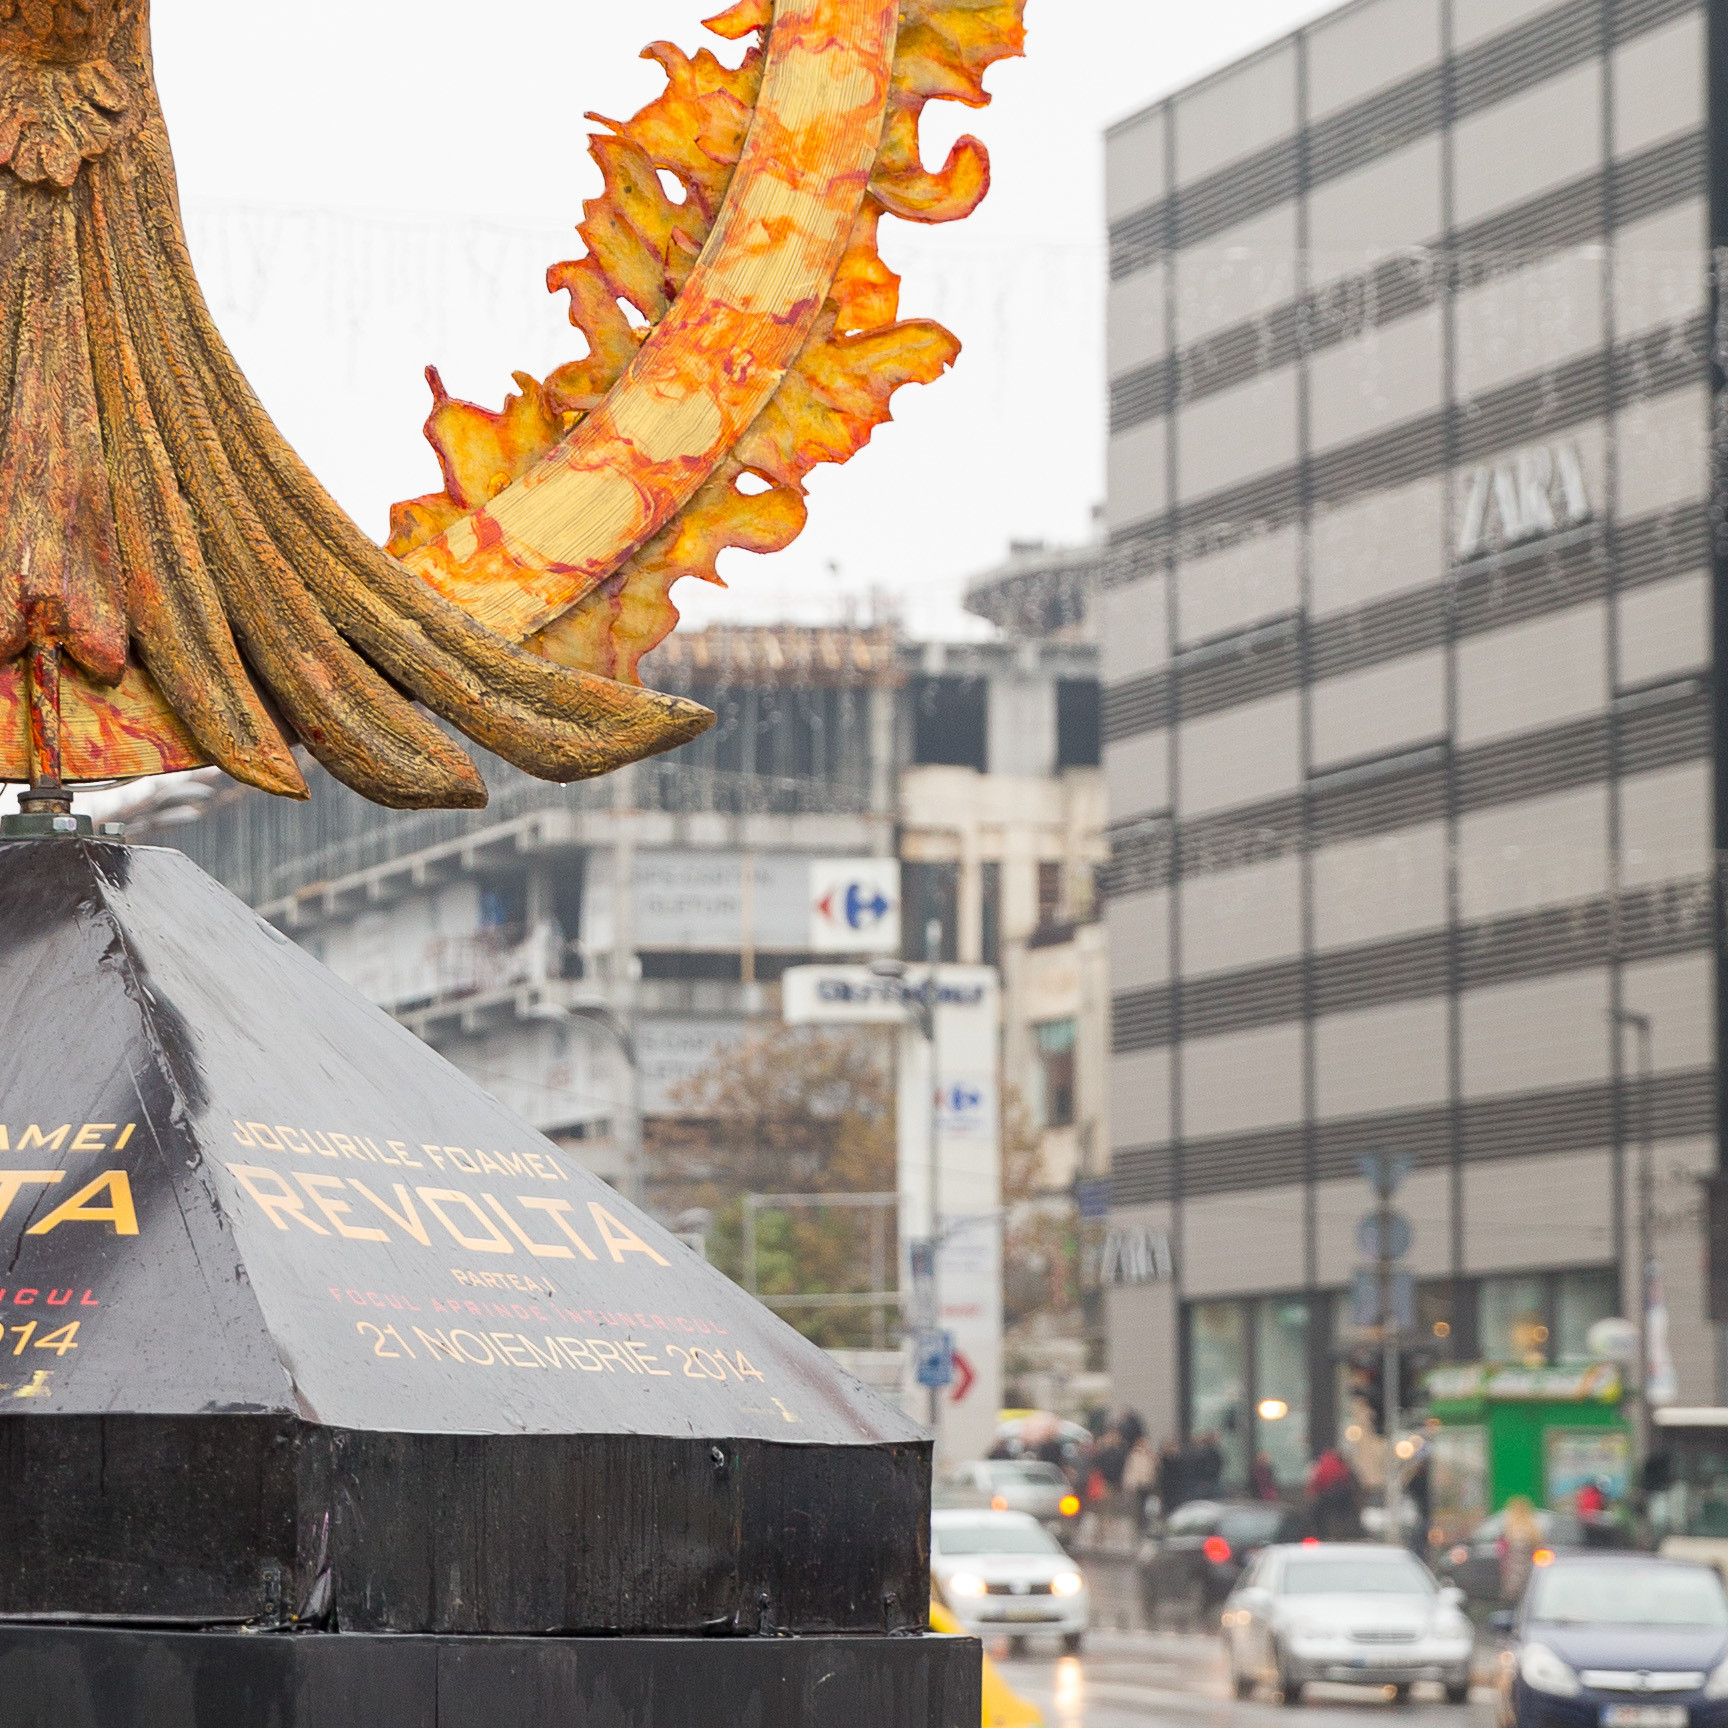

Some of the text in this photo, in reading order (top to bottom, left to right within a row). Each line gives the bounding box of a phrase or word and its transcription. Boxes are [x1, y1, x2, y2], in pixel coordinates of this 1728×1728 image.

[232, 1119, 569, 1181] JOCURILE FOAMEI
[225, 1162, 672, 1267] REVOLTA
[328, 1286, 421, 1311] FOCUL
[431, 1298, 548, 1322] APRINDE
[449, 1268, 543, 1292] PARTEA
[356, 1321, 766, 1384] 21 NOIEMBRIE 2014
